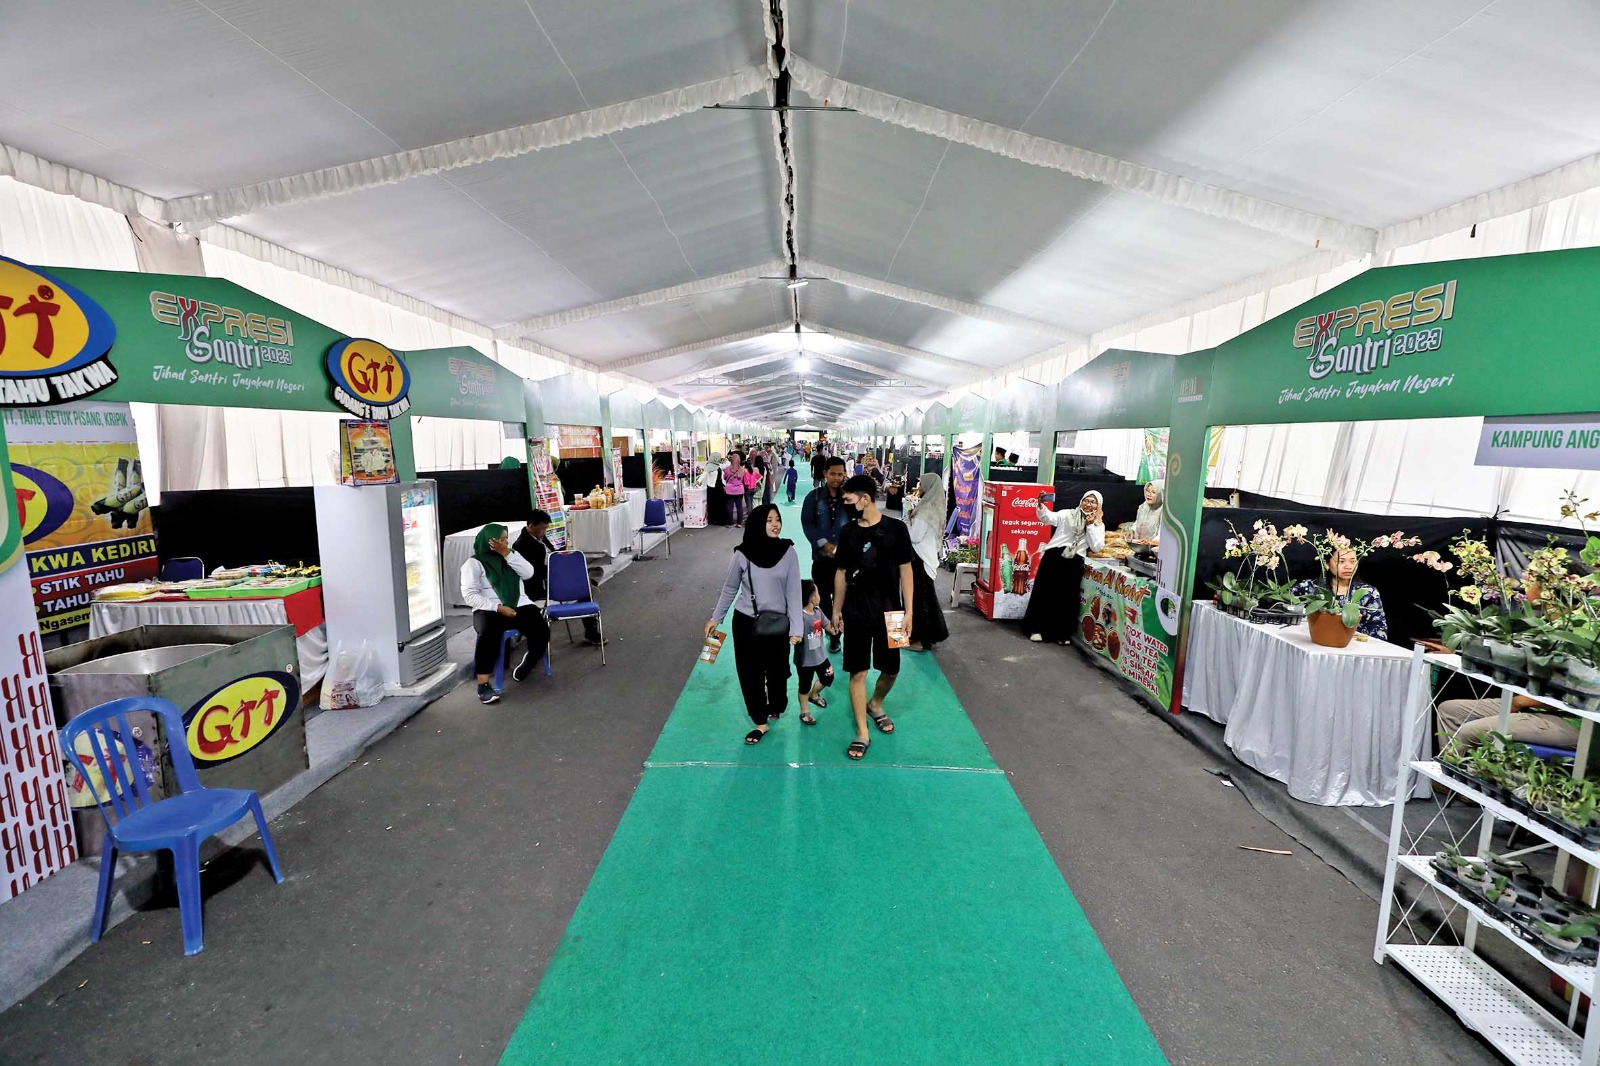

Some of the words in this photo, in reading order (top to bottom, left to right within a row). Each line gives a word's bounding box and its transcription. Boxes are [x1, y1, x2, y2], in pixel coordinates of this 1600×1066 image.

[149, 290, 295, 346] EXPRESI
[1293, 280, 1457, 359] EXPRESI
[185, 325, 262, 369] Santri
[262, 346, 293, 365] 2023
[1308, 328, 1395, 379] Santri
[1392, 327, 1443, 356] 2023
[49, 360, 118, 399] TAKWA
[152, 364, 187, 382] Jihad
[189, 369, 229, 386] Santri
[232, 372, 274, 390] Jayakan
[1278, 388, 1304, 405] Jihad
[1304, 384, 1343, 402] Santri
[1345, 377, 1401, 399] Jayakan
[1402, 373, 1456, 394] Negeri
[45, 410, 75, 427] GETUK
[104, 411, 129, 427] KRIPIK
[1491, 430, 1563, 448] KAMPUNG
[1010, 528, 1039, 536] sekarang
[91, 538, 157, 564] KEDIRI
[39, 577, 82, 595] STIK
[84, 567, 125, 586] TAHU
[42, 592, 90, 614] TAHU
[1143, 633, 1169, 657] WATER
[1144, 645, 1159, 661] TEA
[1142, 655, 1158, 671] TEA
